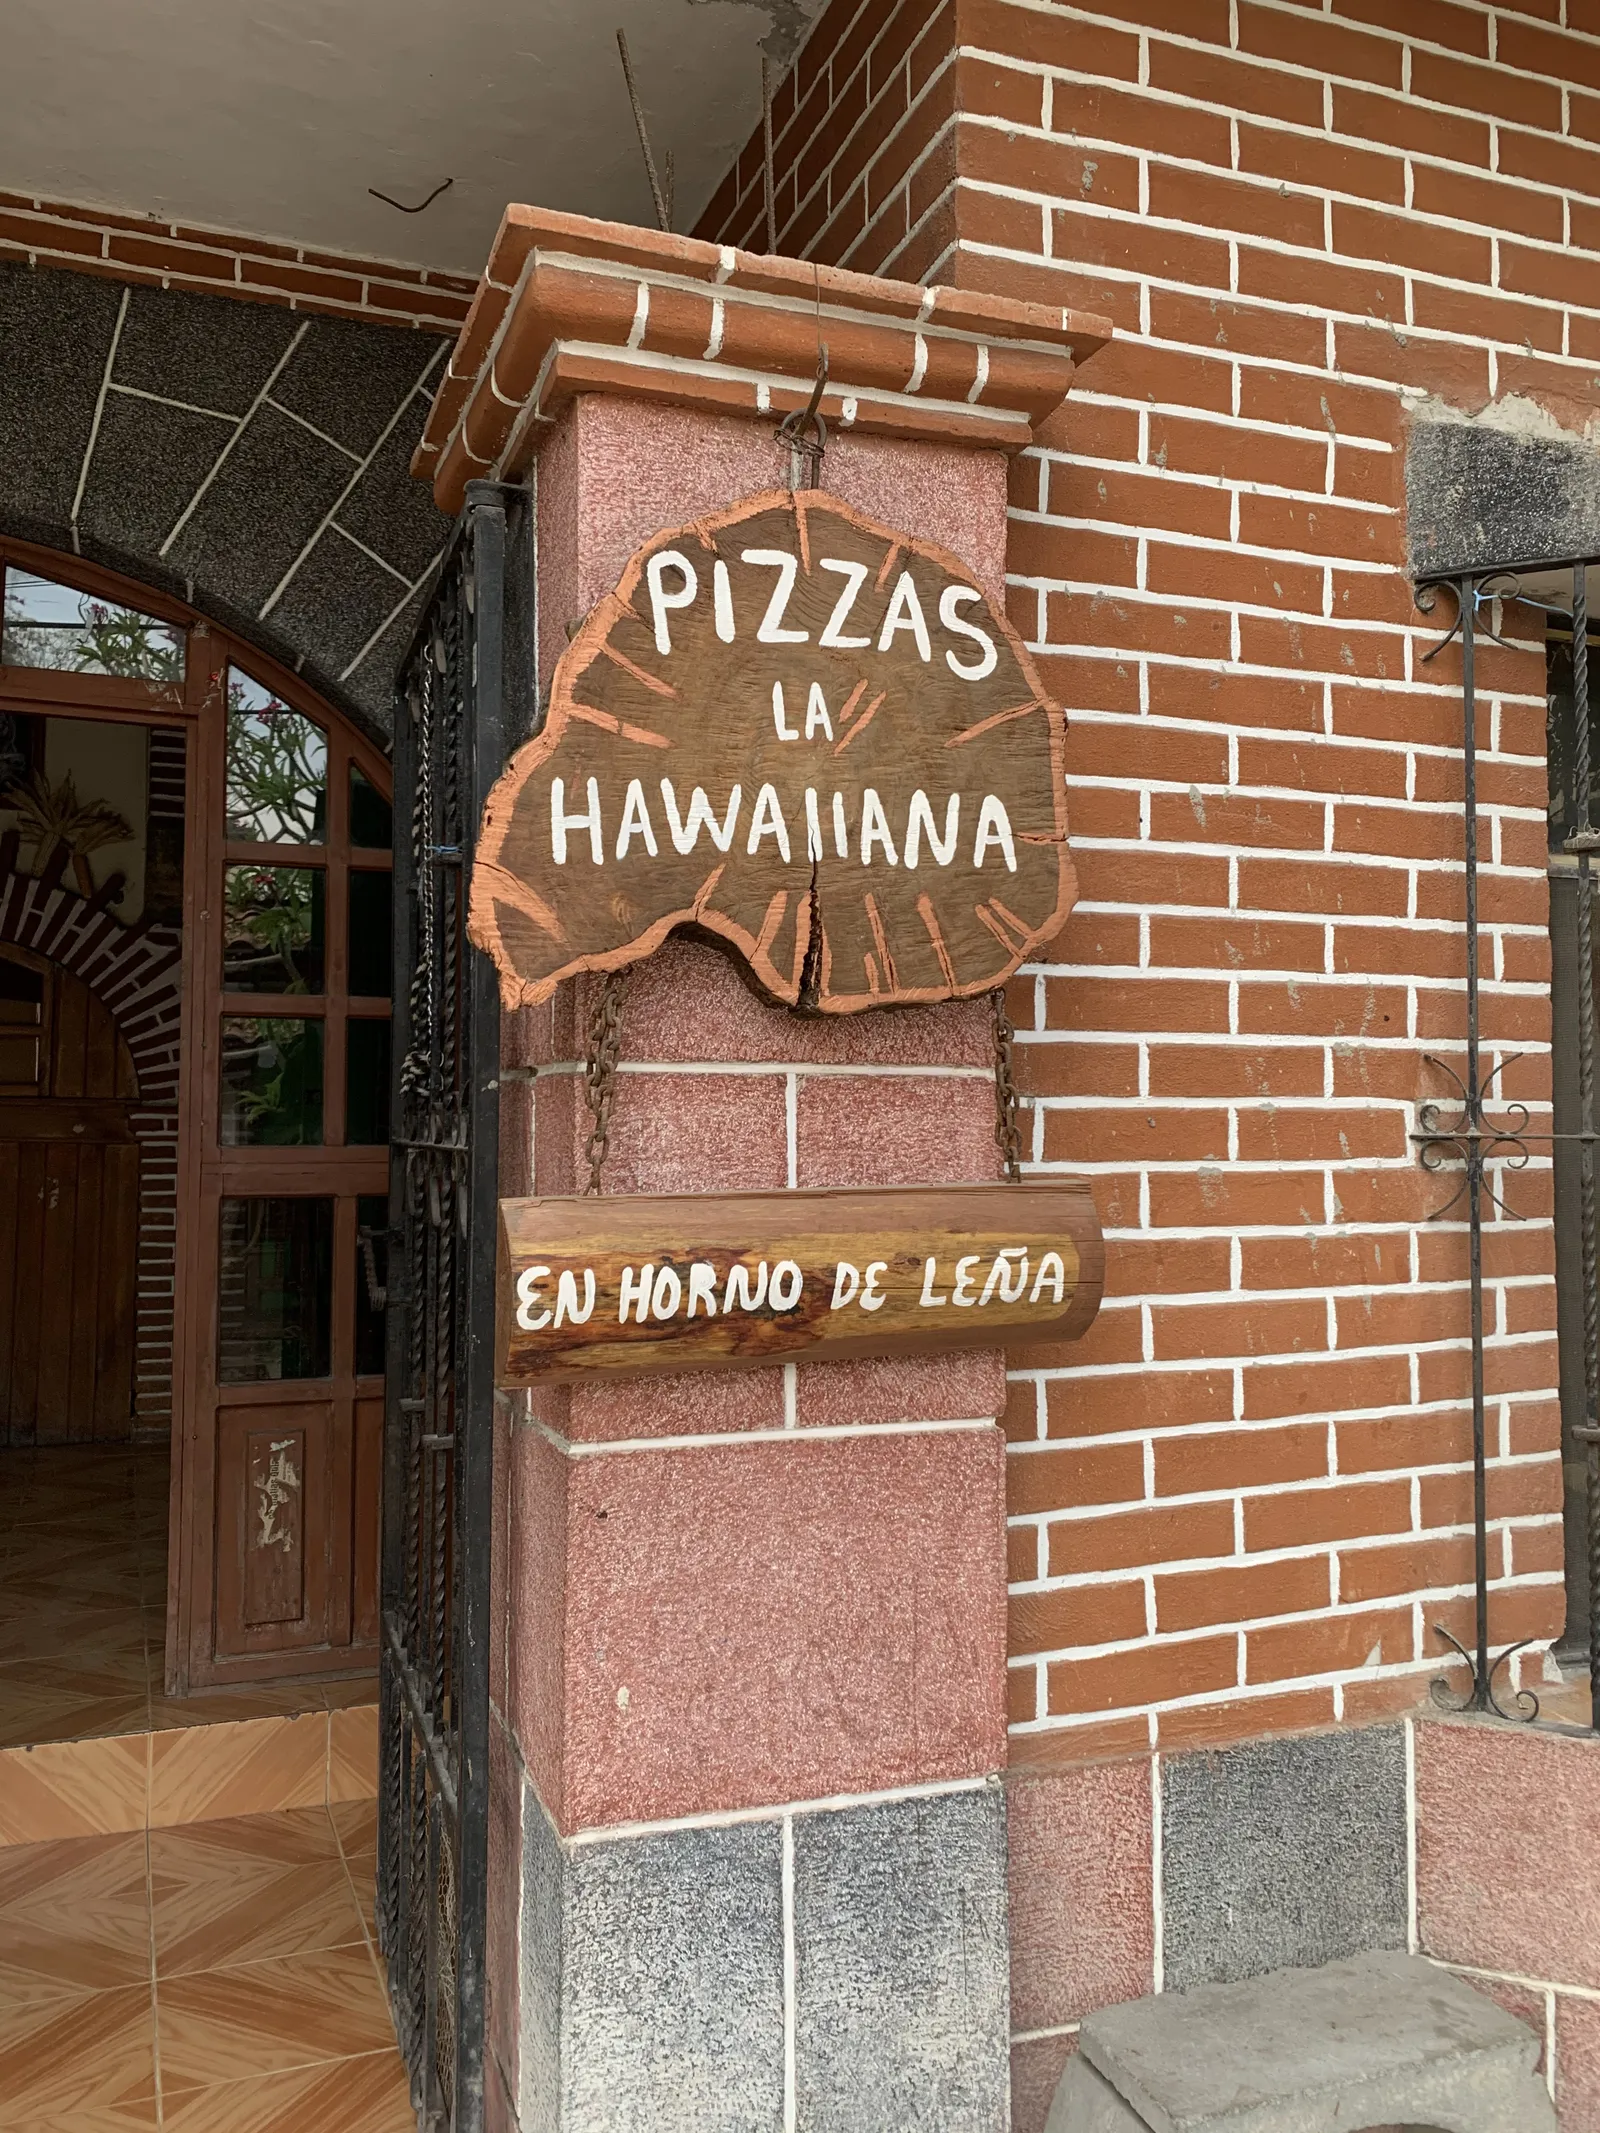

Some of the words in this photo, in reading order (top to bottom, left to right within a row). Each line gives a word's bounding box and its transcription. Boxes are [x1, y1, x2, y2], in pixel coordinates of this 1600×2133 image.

[646, 549, 998, 681] PIZZAS
[772, 681, 833, 742] LA
[550, 776, 1017, 873] HAWAIIANA
[516, 1265, 596, 1330] EN
[619, 1259, 803, 1324] HORNO
[830, 1261, 888, 1311] DE
[919, 1246, 1064, 1307] LEÑA
